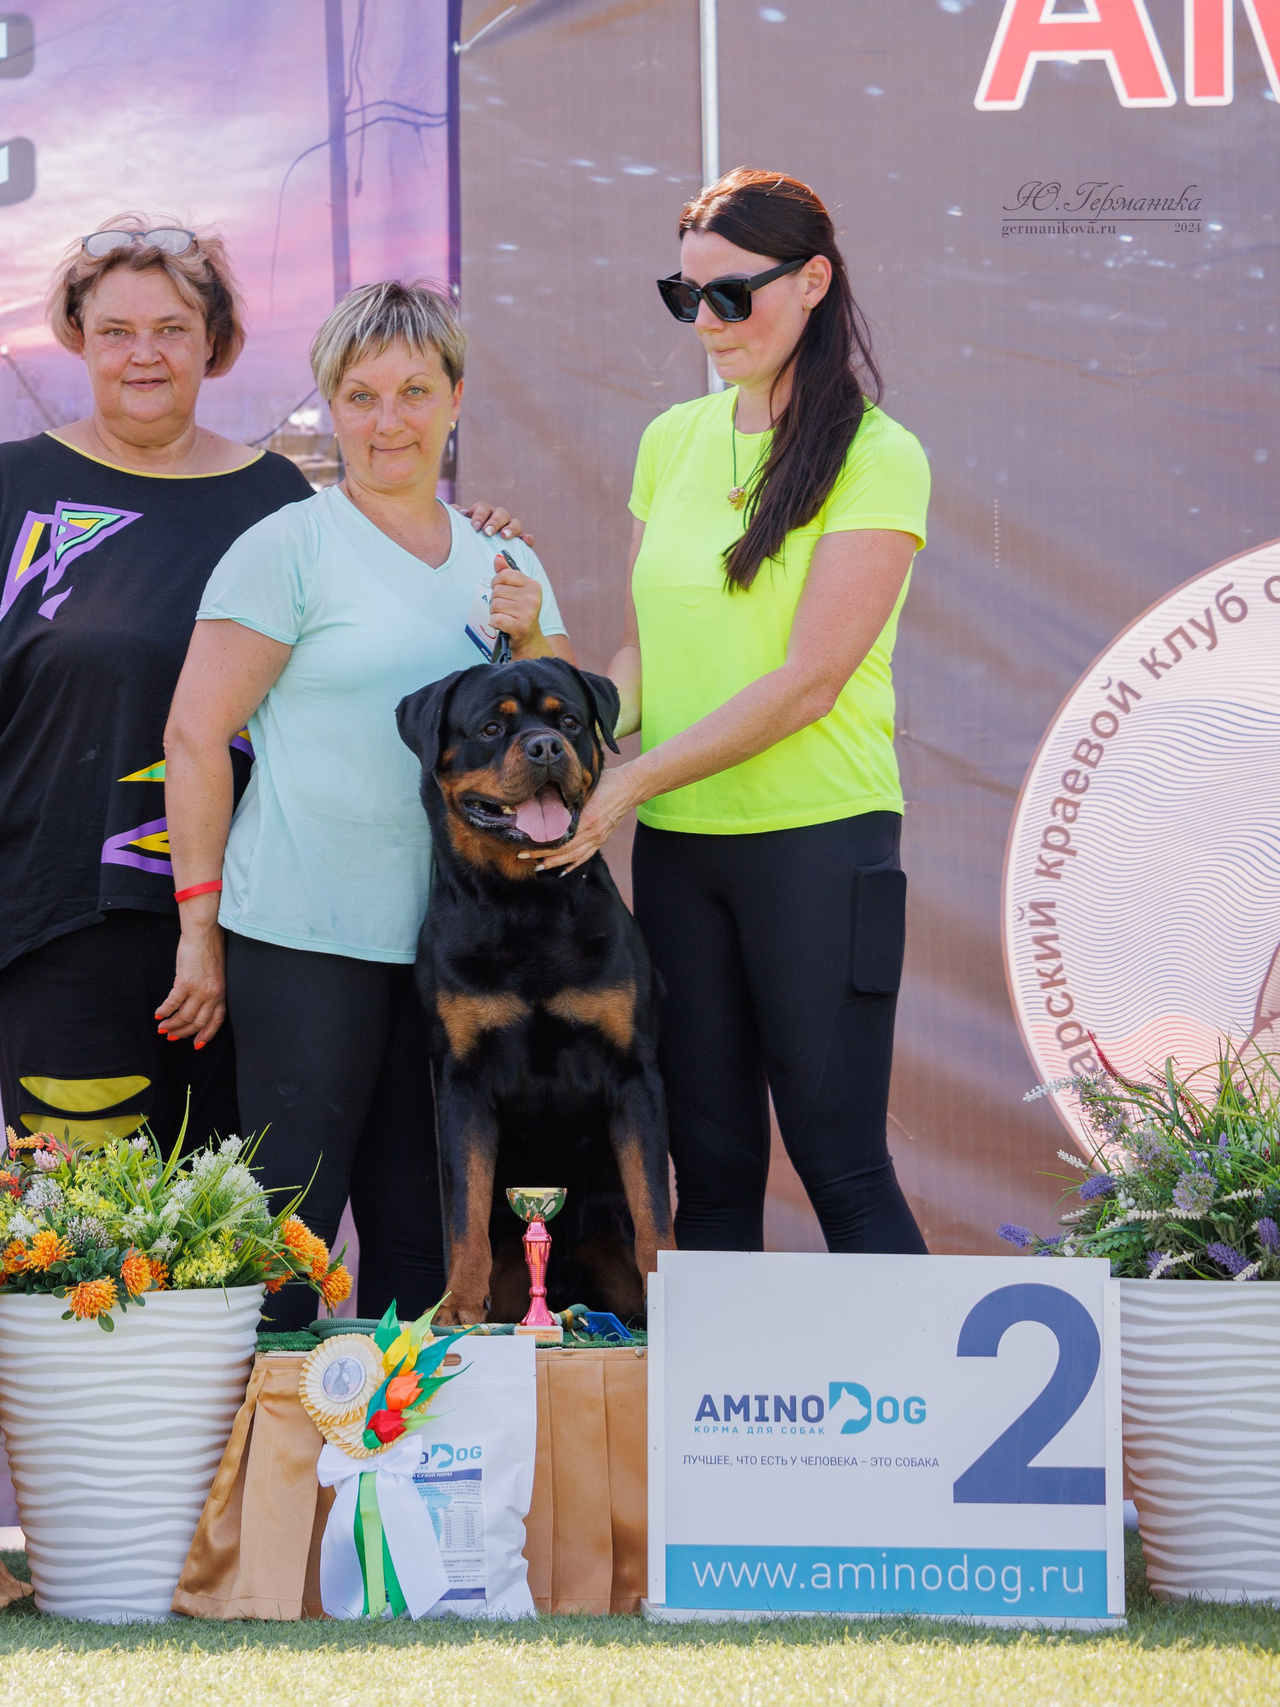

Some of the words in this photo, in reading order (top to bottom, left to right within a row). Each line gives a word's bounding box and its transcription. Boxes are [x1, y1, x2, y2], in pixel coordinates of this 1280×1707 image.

[1034, 676, 1143, 882] краевой
[1138, 582, 1248, 680] клуб
[953, 1282, 1106, 1506] 2
[694, 1425, 739, 1434] КОРМА
[746, 1425, 773, 1435] ДЛЯ
[781, 1426, 825, 1435] СОБАК
[683, 1455, 733, 1467] ЛУЧШЕЕ,
[736, 1455, 758, 1466] ЧТО
[760, 1455, 788, 1466] ЕСТЬ
[790, 1456, 798, 1466] У
[800, 1456, 859, 1467] ЧЕЛОВЕКА
[870, 1457, 892, 1467] ЭТО
[895, 1457, 940, 1468] СОБАКА
[691, 1553, 1084, 1604] www.aminodog.ru
